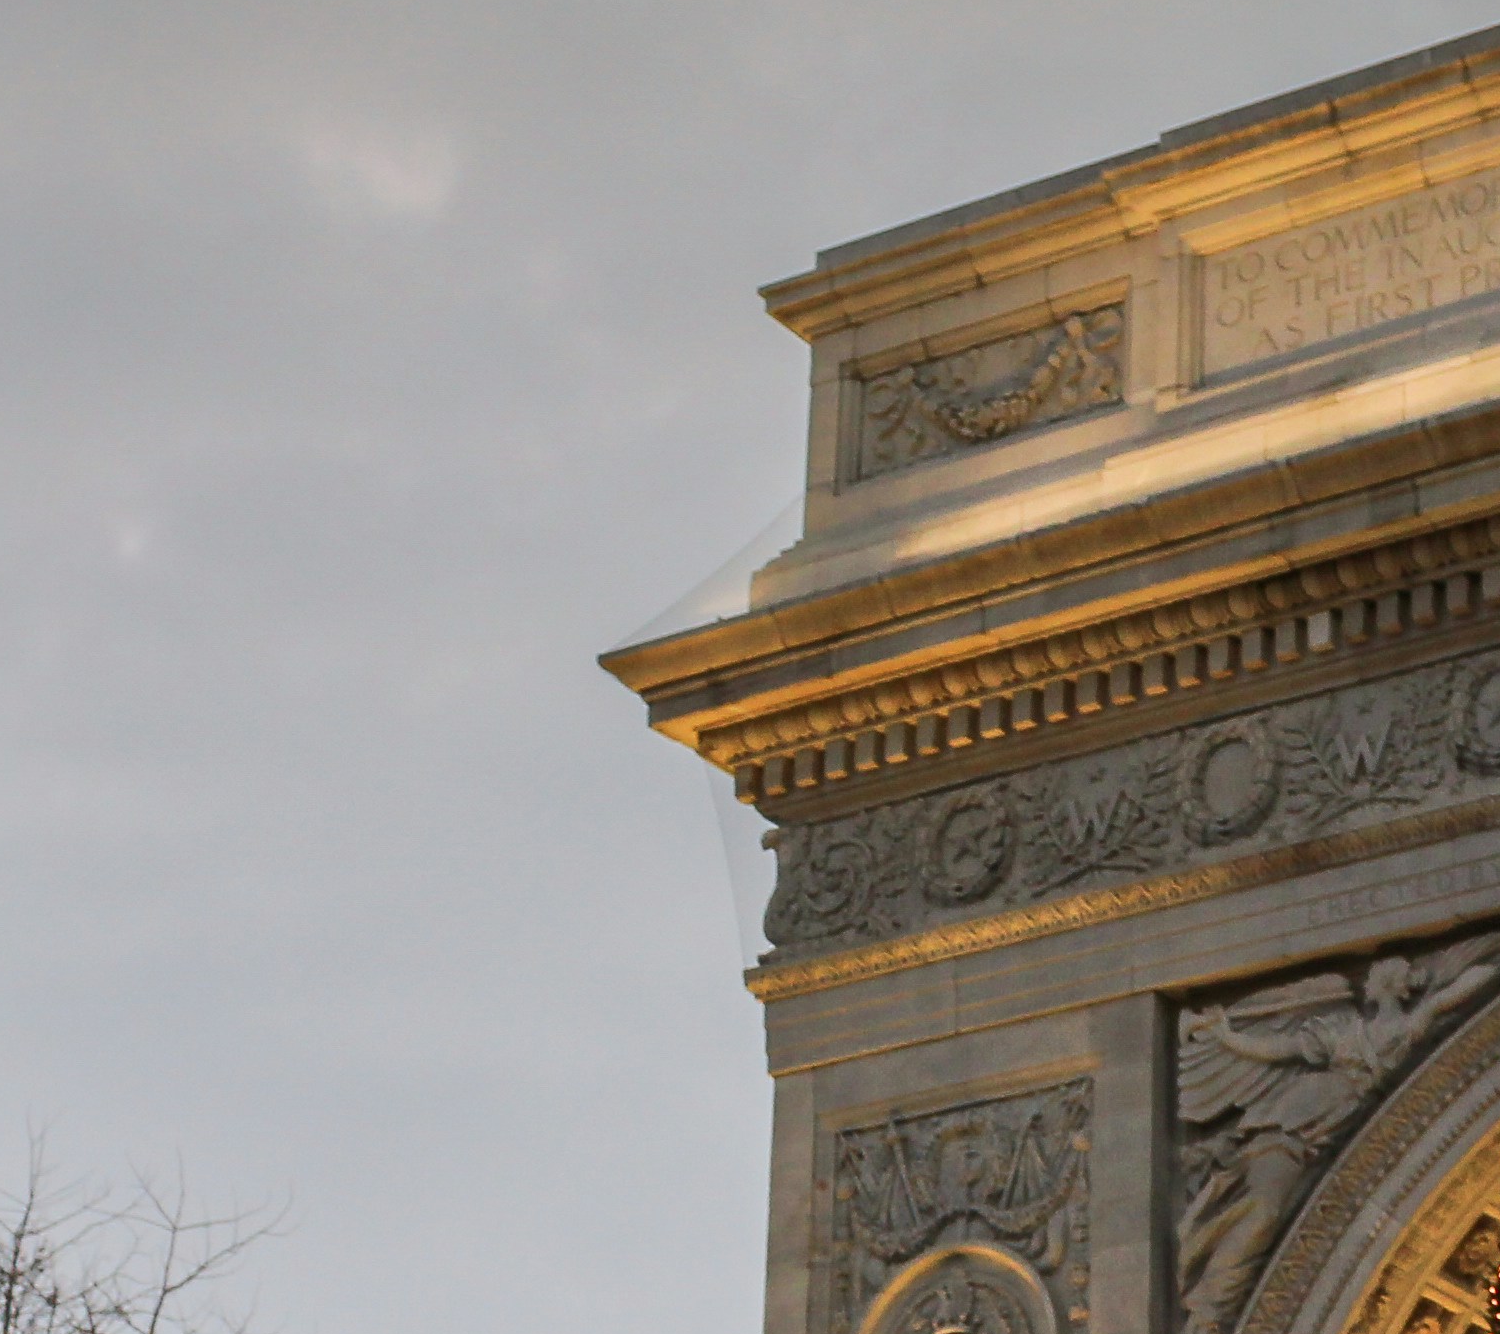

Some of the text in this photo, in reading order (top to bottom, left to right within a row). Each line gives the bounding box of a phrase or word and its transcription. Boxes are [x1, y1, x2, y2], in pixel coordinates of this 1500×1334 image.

[1215, 284, 1270, 328] OF
[1286, 258, 1367, 308] THE
[1216, 251, 1264, 290] TO
[1253, 322, 1305, 354] AS
[1326, 273, 1442, 337] FIRST
[1334, 720, 1394, 778] W
